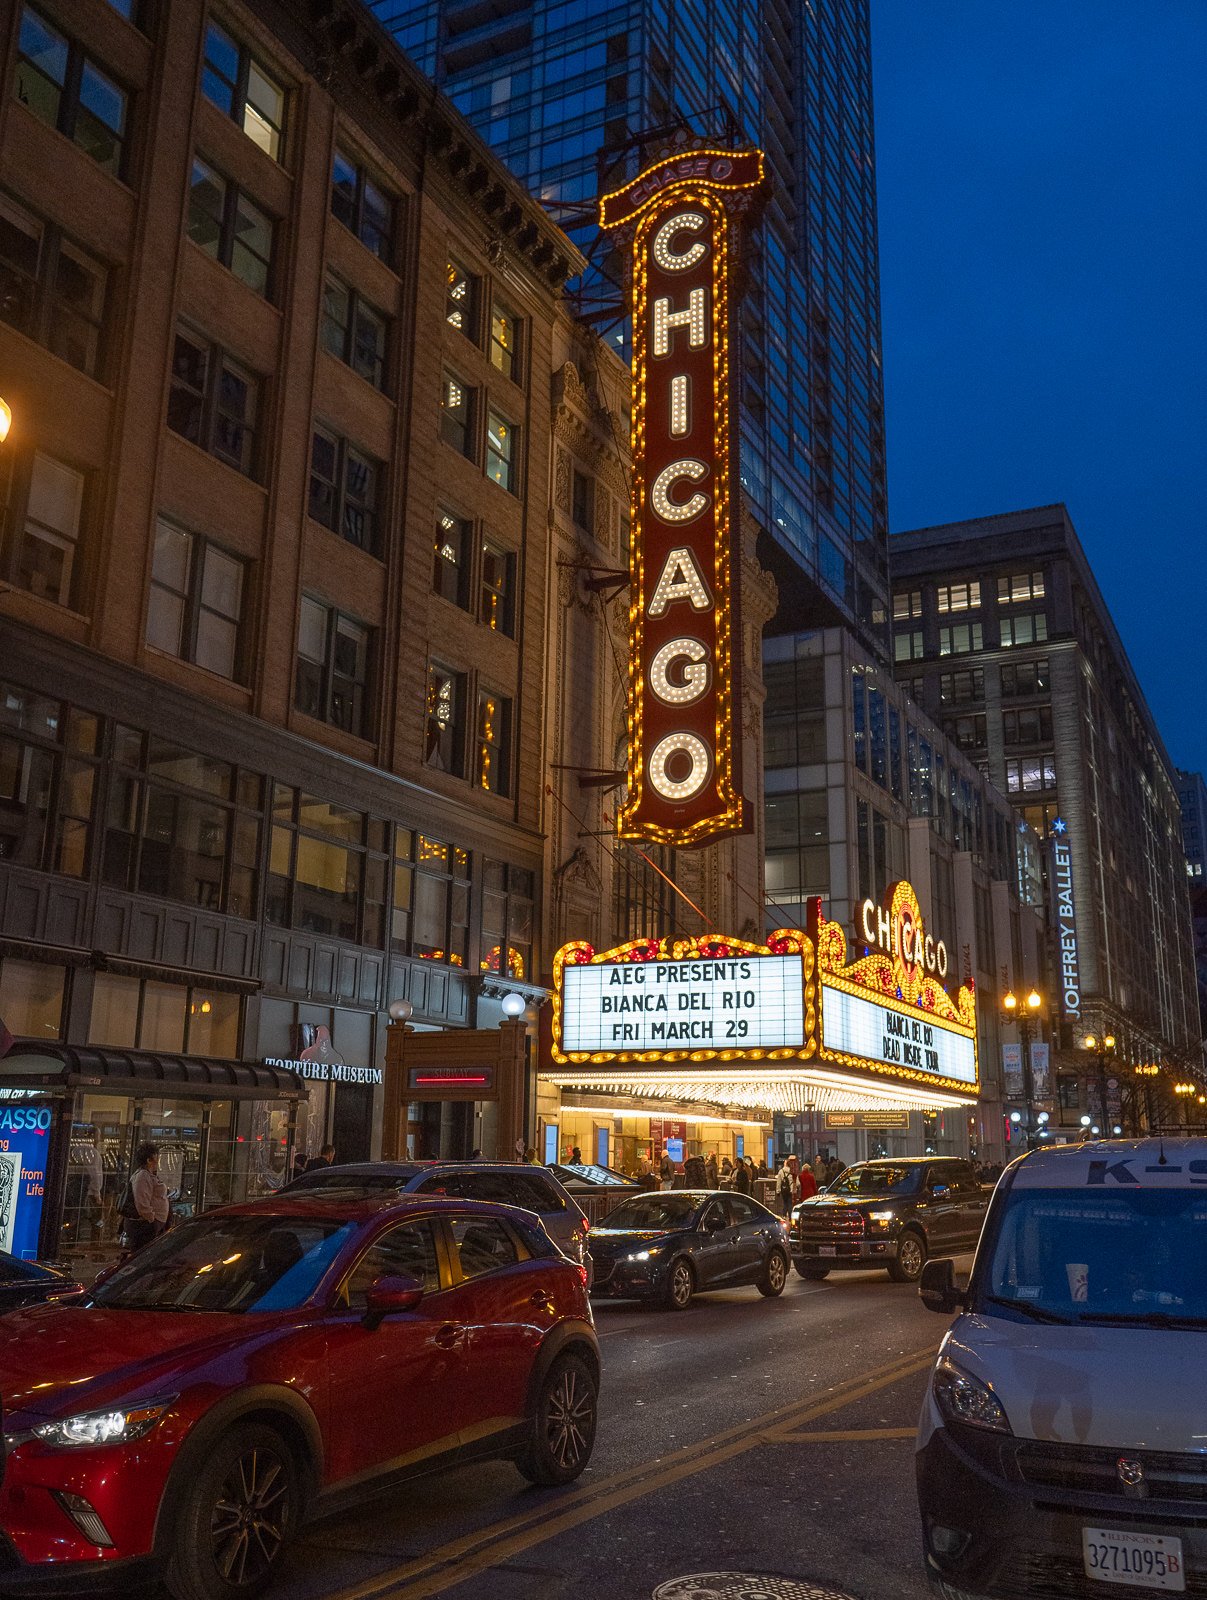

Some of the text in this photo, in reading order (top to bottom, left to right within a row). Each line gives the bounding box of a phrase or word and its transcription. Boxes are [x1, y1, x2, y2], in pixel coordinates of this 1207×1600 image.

[630, 159, 710, 205] CHASE
[649, 213, 709, 799] CHICAGO
[862, 898, 947, 978] CHICAGO
[1054, 841, 1081, 1019] JOFFREY BALLET
[609, 962, 751, 985] AEG PRESENTS
[602, 991, 755, 1013] BIANCA DEL RIO
[612, 1019, 749, 1041] FRI MARCH 29
[886, 1011, 933, 1047] BIANCA DEL RIO
[883, 1036, 940, 1072] DEAD INSIDE TOUR
[331, 1063, 382, 1084] MUSEUM
[0, 1109, 51, 1130] ASSO
[21, 1168, 43, 1180] from
[26, 1183, 44, 1196] Life
[1108, 1533, 1157, 1544] ILLINOIS
